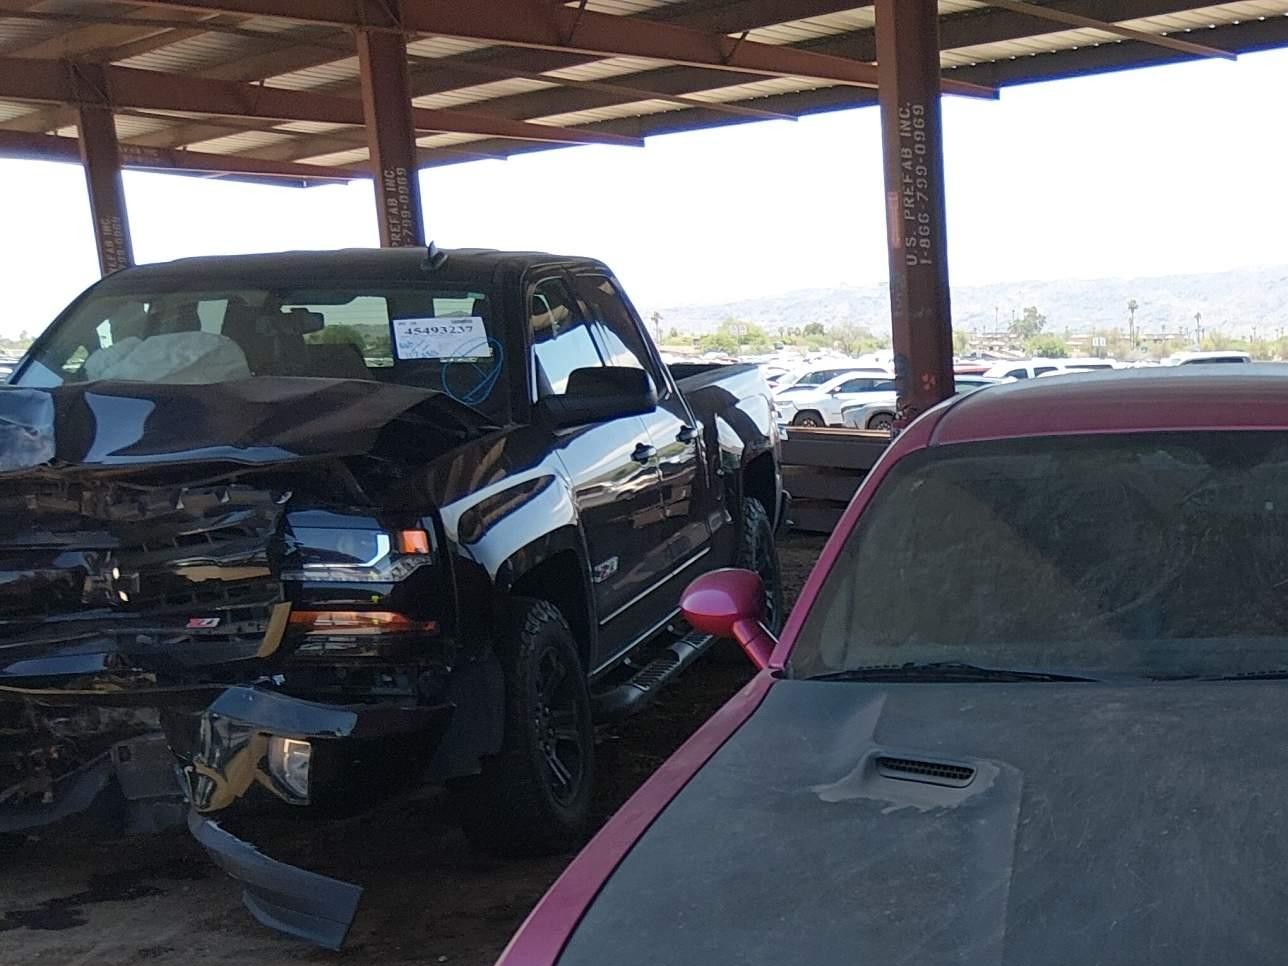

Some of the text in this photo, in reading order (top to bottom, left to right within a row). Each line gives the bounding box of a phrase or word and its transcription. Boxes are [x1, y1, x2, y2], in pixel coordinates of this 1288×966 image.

[899, 101, 919, 266] U.S. PREFAB INC.
[404, 325, 473, 336] 45493237
